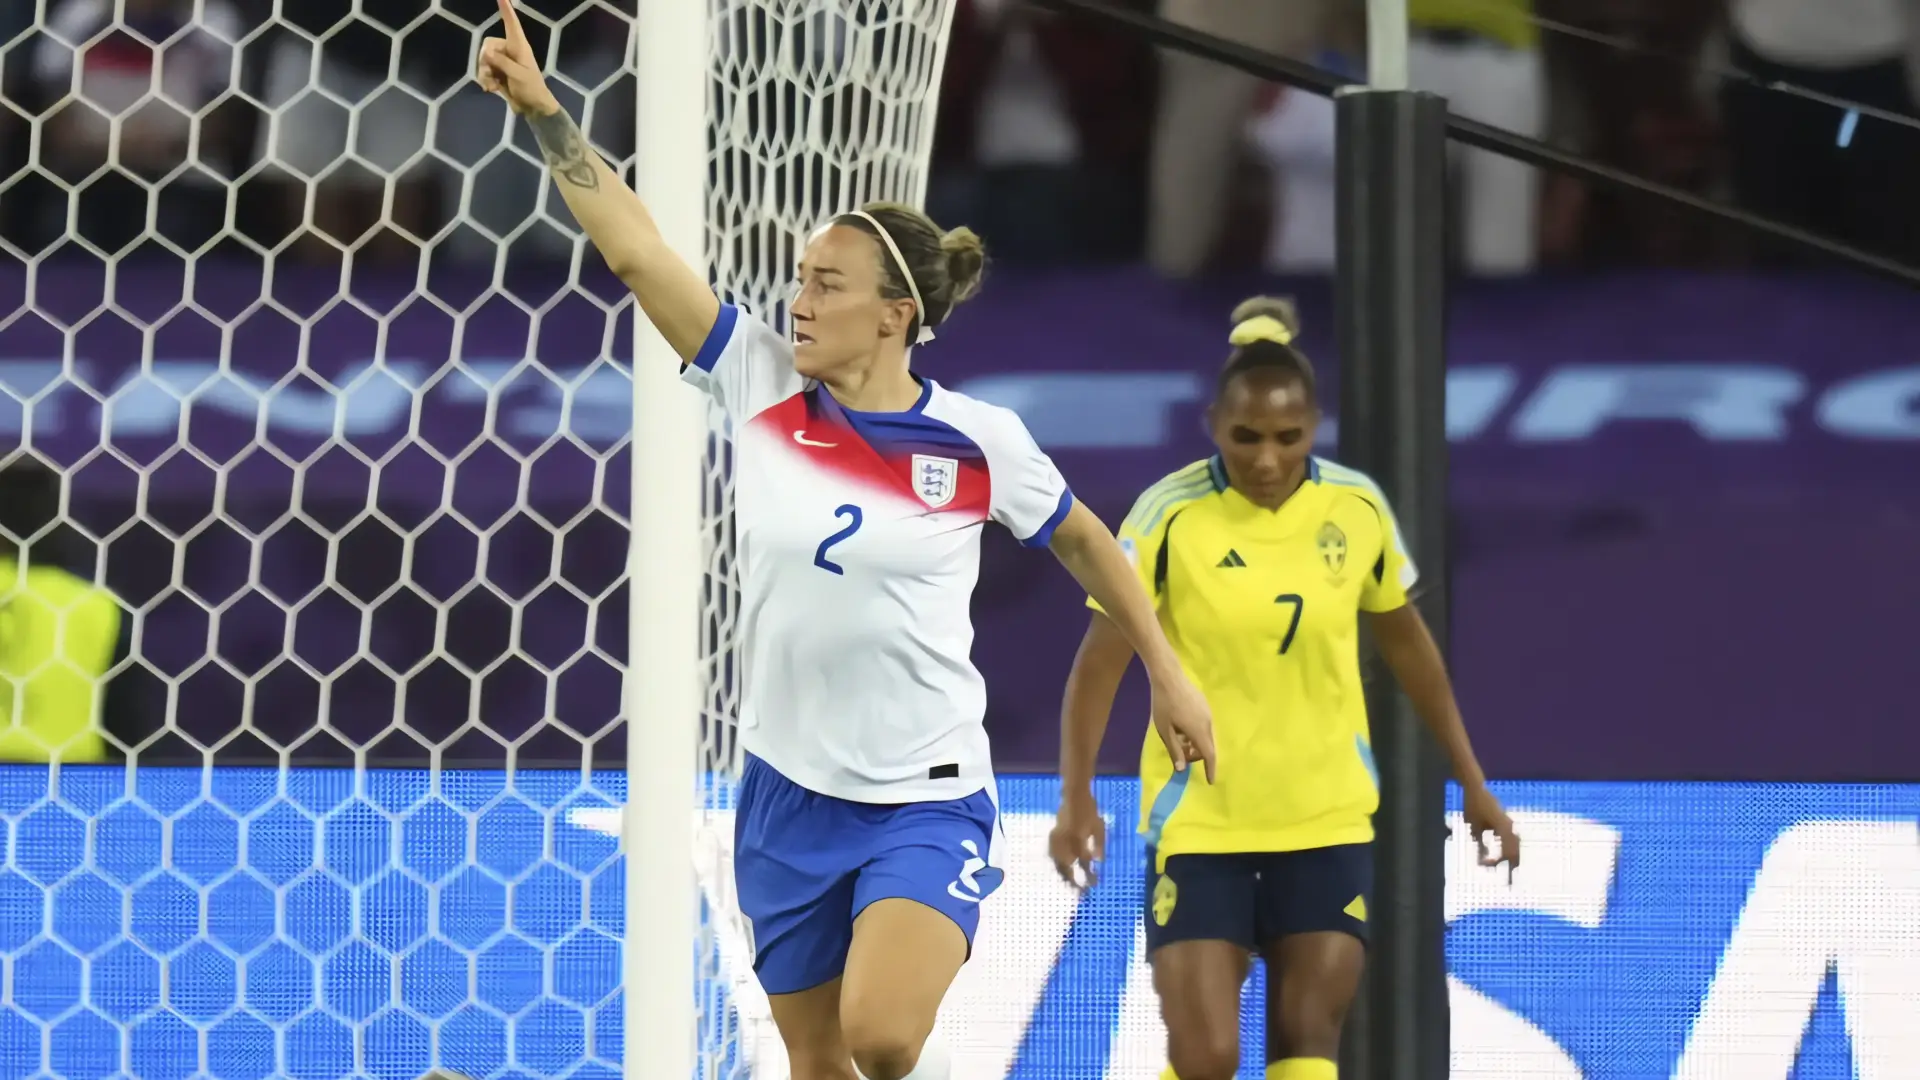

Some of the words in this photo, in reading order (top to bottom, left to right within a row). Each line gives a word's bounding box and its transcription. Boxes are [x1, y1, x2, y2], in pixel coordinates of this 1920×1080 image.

[955, 364, 1920, 446] ER
[814, 503, 863, 576] 2
[1274, 593, 1304, 656] 7
